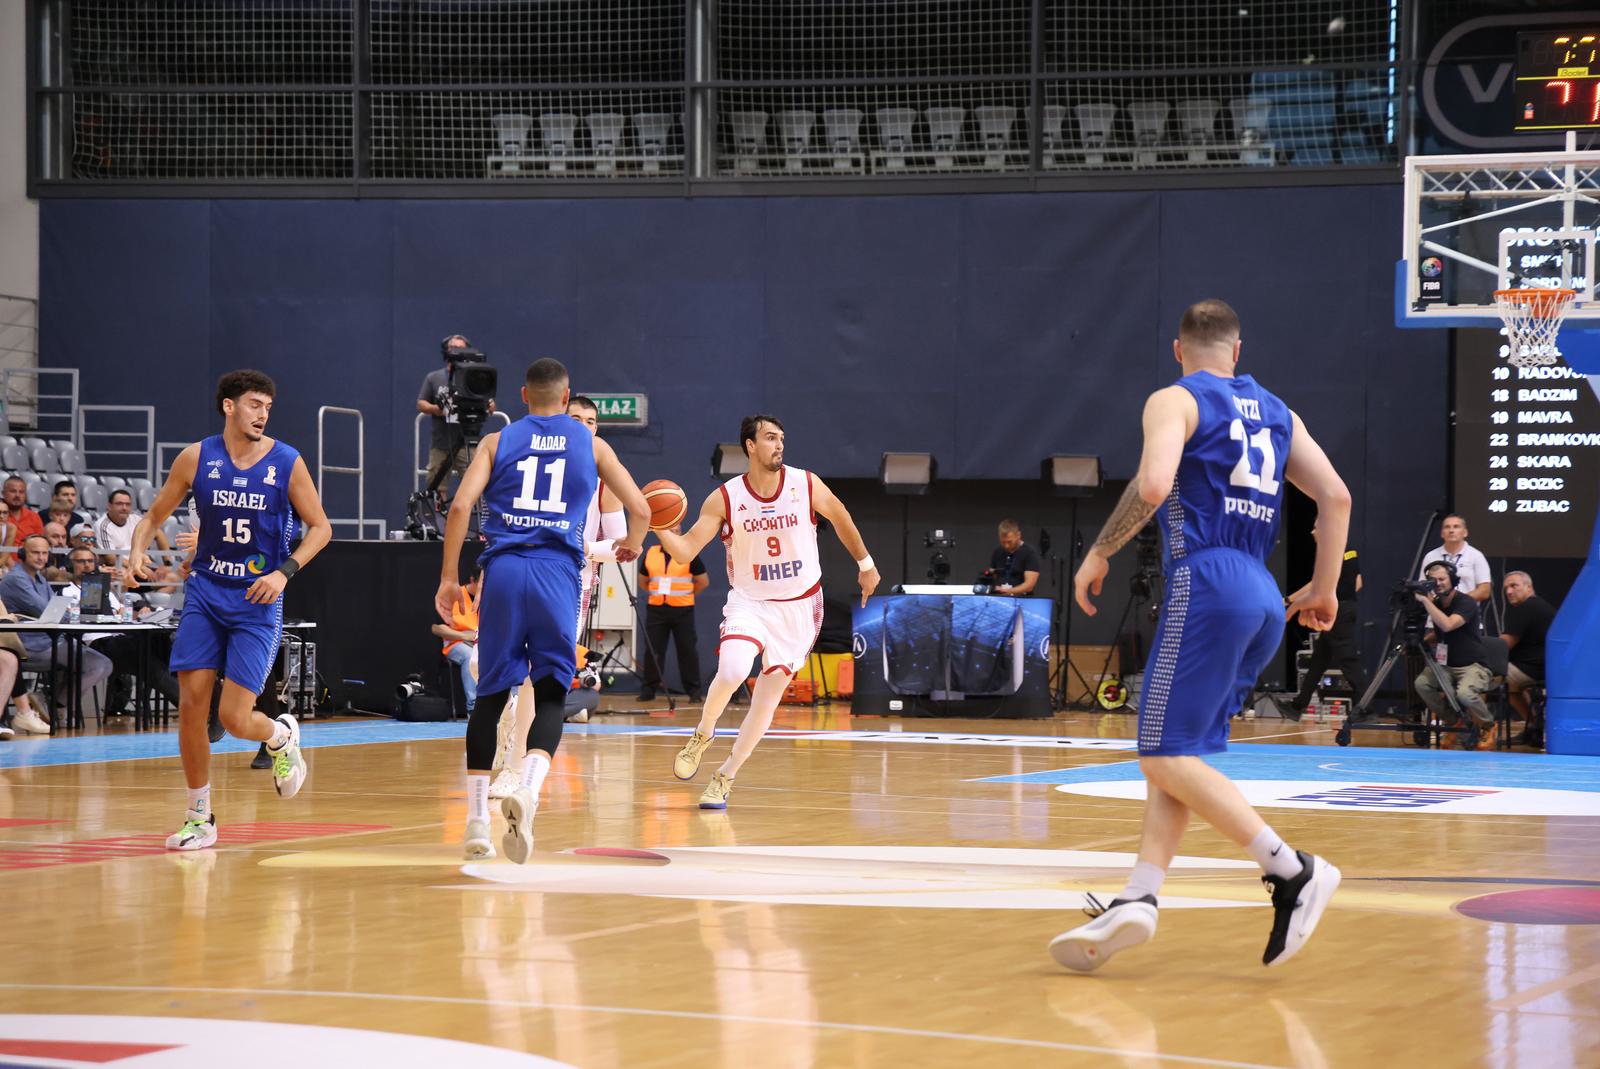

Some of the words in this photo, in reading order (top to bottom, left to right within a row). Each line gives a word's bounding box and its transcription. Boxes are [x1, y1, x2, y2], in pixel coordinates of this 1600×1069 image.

[1491, 367, 1510, 380] 10
[1491, 389, 1509, 402] 18
[1517, 388, 1578, 402] BADZIM
[1491, 411, 1509, 424] 19
[1517, 411, 1574, 424] MAVRA
[529, 433, 567, 451] MADAR
[1489, 433, 1509, 446] 22
[1229, 417, 1280, 496] 21
[1489, 455, 1508, 468] 24
[1516, 455, 1572, 468] SKARA
[512, 455, 567, 514] 11
[1489, 477, 1508, 490] 29
[1516, 477, 1564, 490] BOZIC
[212, 489, 267, 511] ISRAEL
[1488, 500, 1507, 512] 40
[1515, 499, 1570, 512] ZUBAC
[222, 517, 252, 545] 15
[743, 513, 799, 533] CROATIA
[766, 536, 782, 557] 9
[208, 555, 246, 577] הראל
[768, 559, 803, 580] HEP
